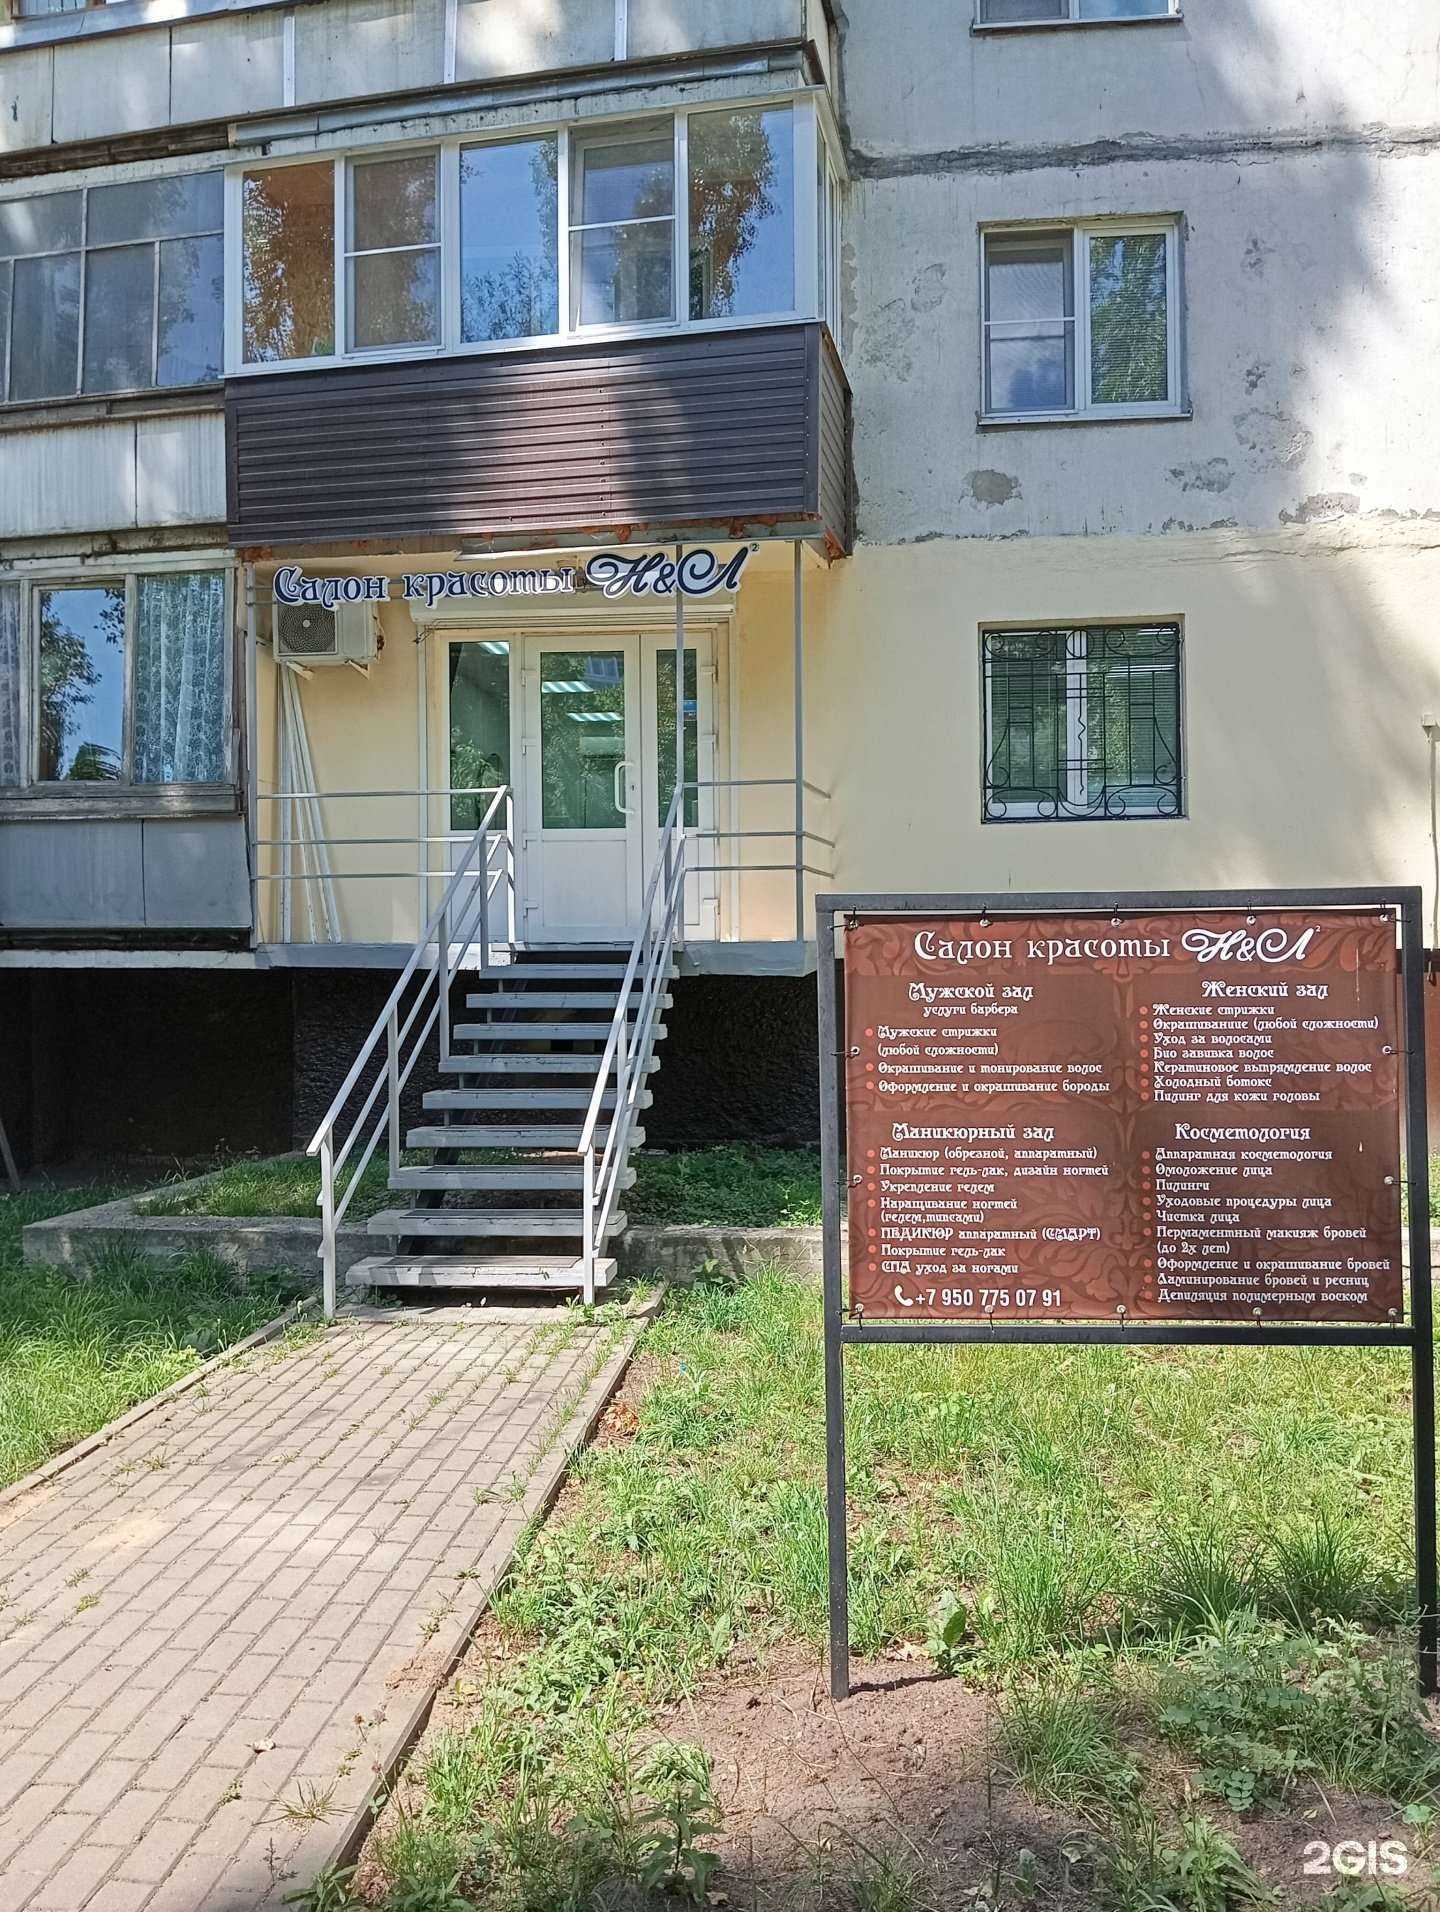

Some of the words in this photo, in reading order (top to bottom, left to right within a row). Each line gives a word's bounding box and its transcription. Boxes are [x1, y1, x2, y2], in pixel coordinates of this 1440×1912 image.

[274, 566, 387, 608] Салон
[403, 567, 574, 607] красоты
[914, 931, 1012, 965] Салон
[1027, 938, 1170, 965] красоты
[909, 983, 994, 1002] Мужской
[1002, 986, 1033, 1001] зал
[1202, 981, 1288, 997] Женский
[1296, 984, 1328, 999] зал
[923, 1006, 966, 1017] услуги
[971, 1003, 1017, 1016] барбера
[1153, 1004, 1212, 1015] Женские
[1217, 1006, 1274, 1016] стрижки
[1254, 1017, 1296, 1031] (любой
[1302, 1017, 1378, 1031] сложности)
[878, 1026, 937, 1039] Мужские
[942, 1028, 997, 1038] стрижки
[1154, 1034, 1186, 1045] Уход
[1192, 1035, 1206, 1044] за
[1212, 1035, 1271, 1045] волосами
[878, 1044, 920, 1057] (любой
[925, 1043, 998, 1057] сложности)
[1154, 1048, 1176, 1060] Био
[1182, 1050, 1233, 1058] завивка
[1239, 1050, 1274, 1060] волос
[879, 1063, 963, 1075] Окрашивание
[969, 1065, 975, 1073] и
[980, 1064, 1062, 1075] тонирование
[1067, 1064, 1102, 1074] волос
[1154, 1062, 1239, 1074] Кератиновое
[1336, 1064, 1372, 1074] волос
[879, 1081, 956, 1094] Оформление
[962, 1084, 969, 1092] и
[974, 1083, 1057, 1093] окрашивание
[1063, 1079, 1110, 1093] бороды
[1154, 1076, 1221, 1088] Холодный
[1227, 1076, 1271, 1087] ботокс
[1154, 1090, 1201, 1103] Пилинг
[1207, 1092, 1228, 1102] для
[1234, 1092, 1267, 1101] кожи
[1274, 1092, 1320, 1103] головы
[892, 1122, 1015, 1142] Маникюрный
[1023, 1126, 1054, 1142] зал
[1175, 1124, 1311, 1142] Косметология
[880, 1147, 940, 1160] Маникюр
[945, 1147, 1009, 1160] (обрезной,
[1014, 1147, 1097, 1161] аппаратный)
[1156, 1148, 1236, 1161] Аппаратная
[1241, 1151, 1332, 1161] косметология
[880, 1164, 945, 1177] Покрытие
[950, 1166, 1008, 1177] гель-лак,
[1014, 1164, 1058, 1176] дизайн
[1063, 1164, 1109, 1176] ногтей
[1156, 1165, 1238, 1176] Омоложение
[1243, 1166, 1272, 1177] лица
[880, 1181, 952, 1193] Укрепление
[957, 1183, 995, 1193] гелем
[1157, 1179, 1210, 1191] Пилинги
[881, 1198, 967, 1210] Наращивание
[972, 1198, 1017, 1209] ногтей
[1157, 1195, 1221, 1206] Уходовые
[1226, 1197, 1296, 1208] процедуры
[1302, 1197, 1332, 1208] лица
[1157, 1211, 1204, 1222] Чистка
[1210, 1213, 1240, 1224] лица
[959, 1229, 1036, 1241] аппаратный
[1266, 1228, 1318, 1239] макияж
[1324, 1226, 1366, 1239] бровей
[881, 1245, 946, 1257] Покрытие
[951, 1246, 1005, 1257] гель-лак
[1157, 1242, 1176, 1254] (до
[1202, 1242, 1230, 1255] лет)
[882, 1261, 911, 1273] СПА
[916, 1264, 946, 1275] уход
[952, 1264, 966, 1273] за
[971, 1264, 1019, 1275] ногами
[1158, 1258, 1238, 1270] Оформление
[1244, 1260, 1250, 1269] и
[1256, 1260, 1342, 1270] окрашивание
[1347, 1258, 1390, 1271] бровей
[1158, 1274, 1259, 1286] Ламинирование
[1265, 1273, 1307, 1287] бровей
[1313, 1276, 1319, 1285] и
[1325, 1276, 1369, 1288] ресниц
[916, 1289, 936, 1305] +7
[942, 1290, 973, 1306] 950
[979, 1290, 1009, 1306] 775
[1016, 1290, 1036, 1306] 07
[1042, 1290, 1061, 1306] 91
[1158, 1290, 1227, 1303] Депиляция
[1232, 1292, 1316, 1303] полимерным
[1321, 1291, 1367, 1302] воском
